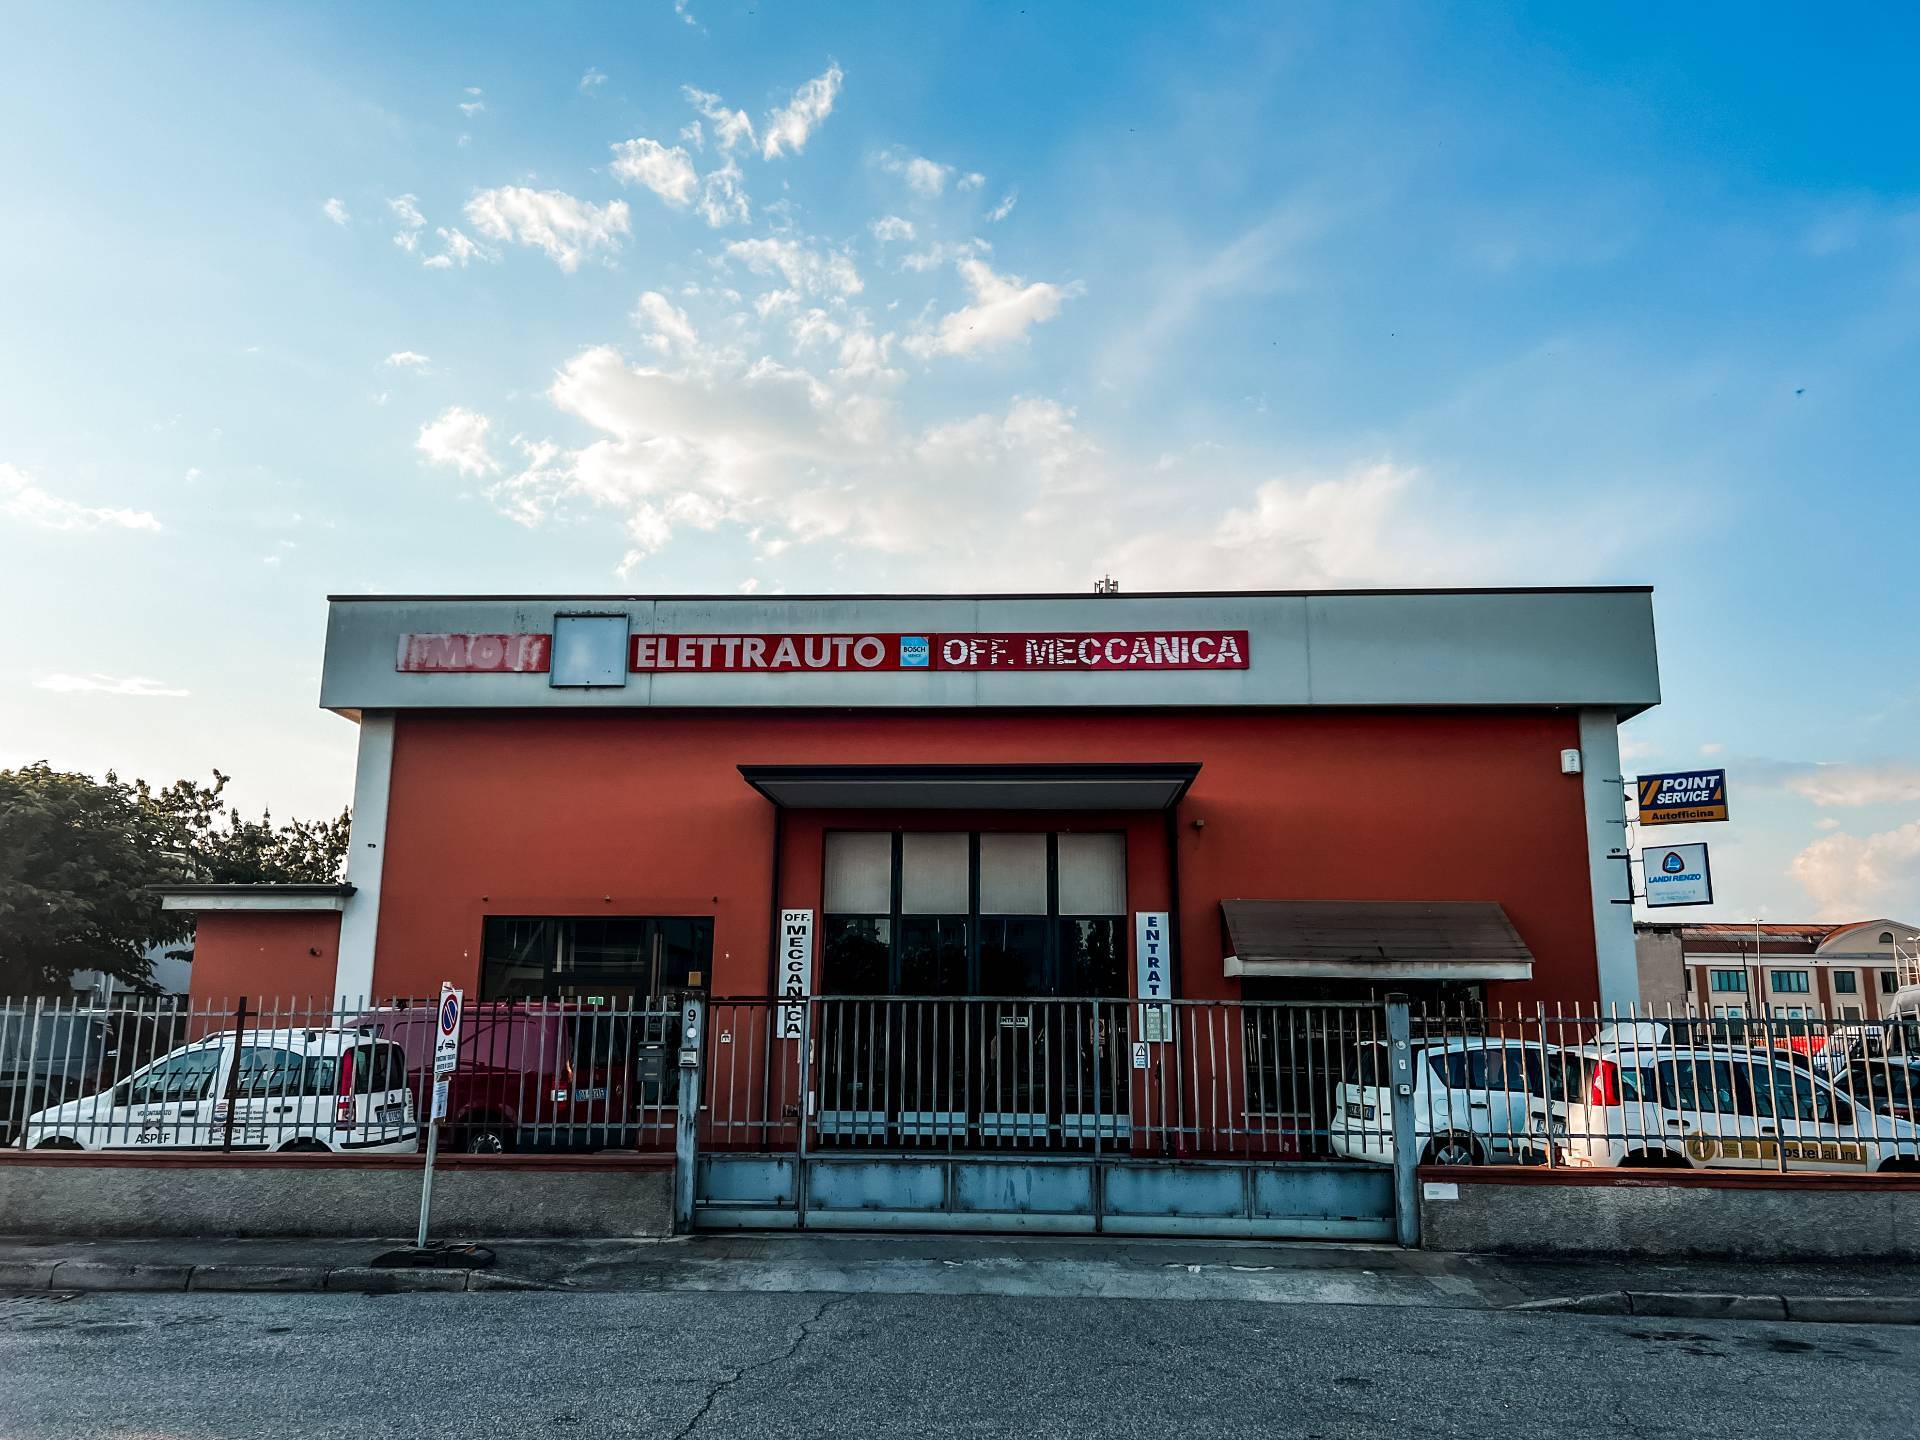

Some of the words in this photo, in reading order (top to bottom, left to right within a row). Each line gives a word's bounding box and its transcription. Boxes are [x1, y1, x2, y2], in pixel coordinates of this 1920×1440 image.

[636, 636, 886, 668] ELETTRAUTO
[942, 638, 1014, 665] OFF.
[1025, 636, 1243, 665] MECCANICA
[1662, 775, 1720, 791] POINT
[1657, 790, 1710, 804] SERVICE
[1651, 810, 1714, 821] Autofficina
[1648, 875, 1672, 884] LANDI
[1672, 873, 1702, 882] RENZO
[784, 913, 810, 922] OFF.
[687, 1009, 696, 1021] 9
